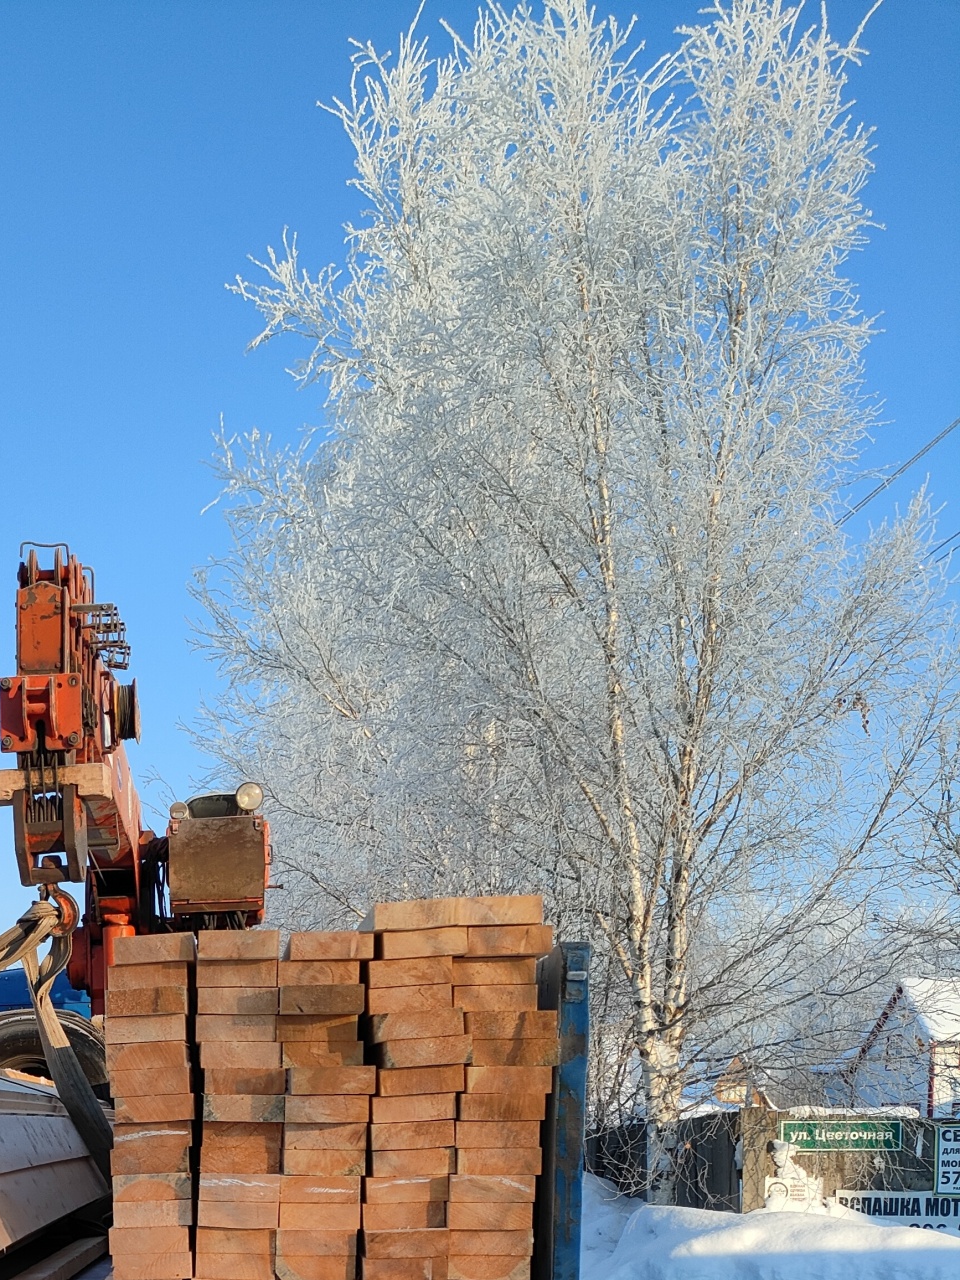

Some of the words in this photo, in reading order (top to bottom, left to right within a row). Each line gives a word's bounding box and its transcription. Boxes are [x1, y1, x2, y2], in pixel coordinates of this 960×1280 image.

[789, 1131, 811, 1142] ул.
[815, 1129, 893, 1142] Цветочная
[941, 1159, 960, 1168] МО
[925, 1197, 960, 1217] МОТ
